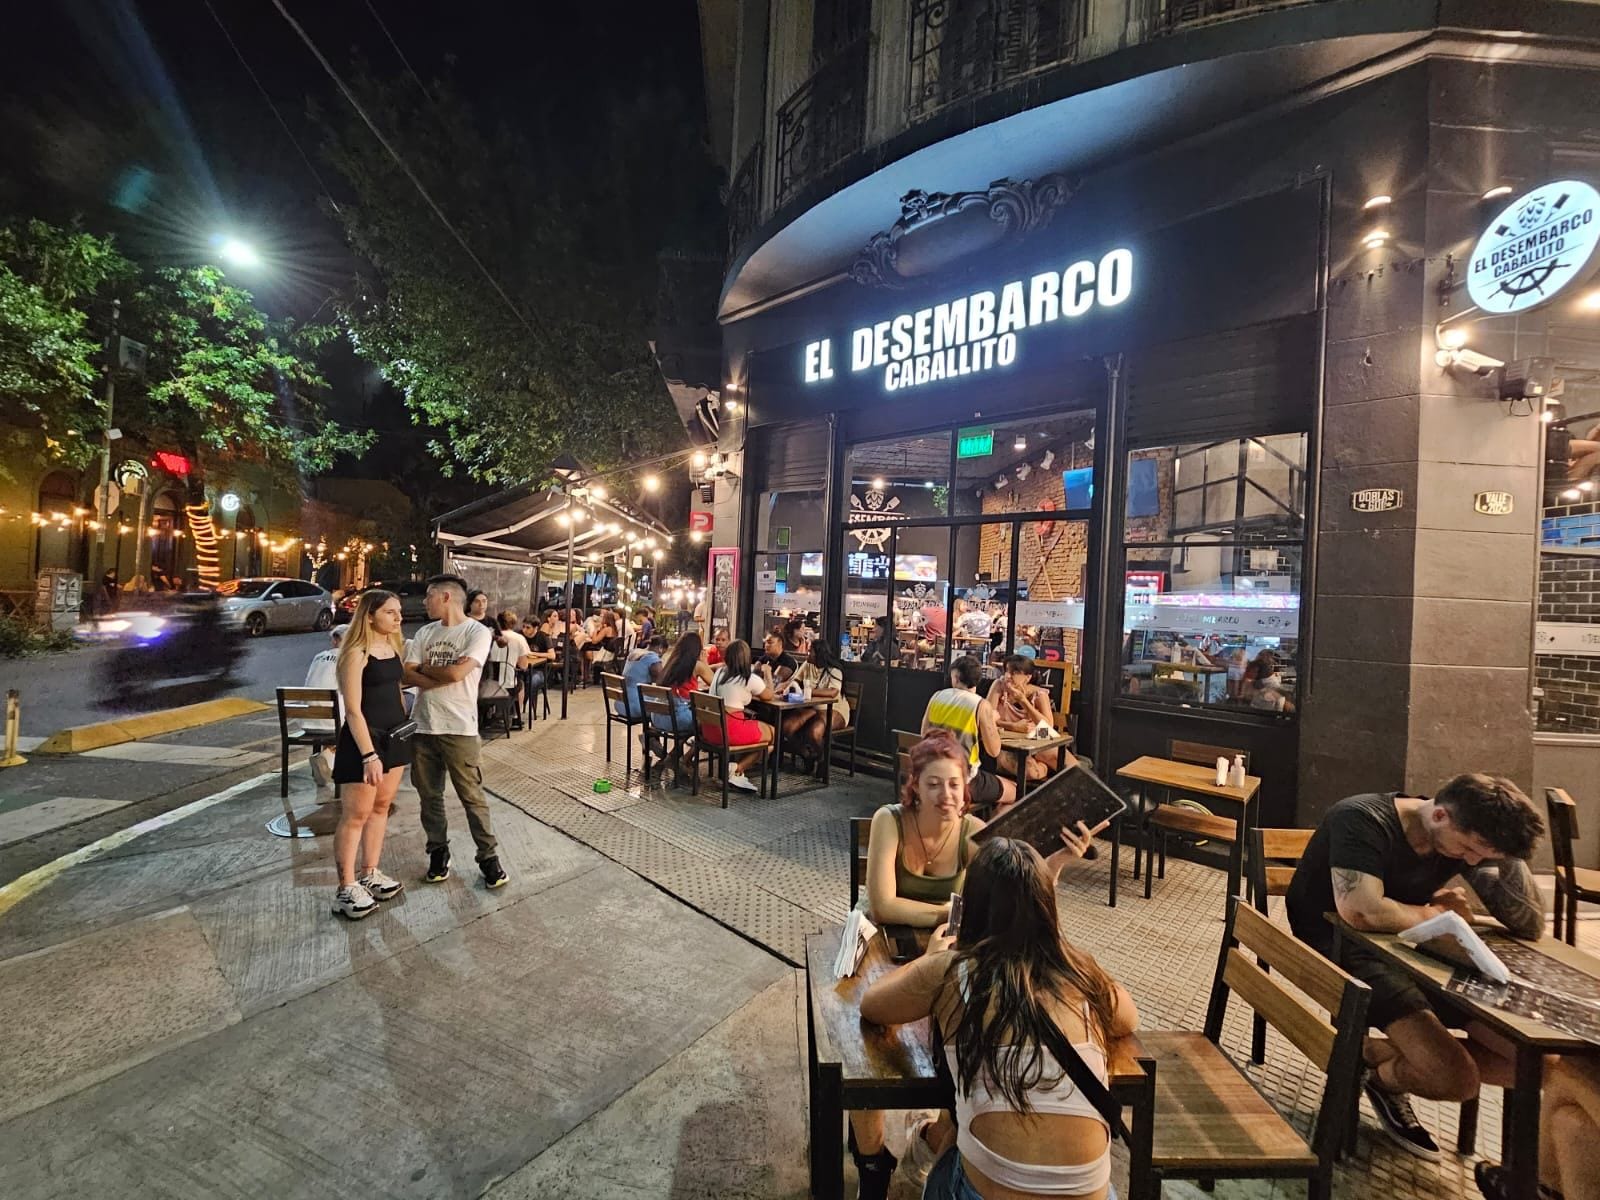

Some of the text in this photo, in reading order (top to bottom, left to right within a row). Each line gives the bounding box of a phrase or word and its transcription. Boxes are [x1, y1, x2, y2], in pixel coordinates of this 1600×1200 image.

[1474, 208, 1593, 274] EL DESEMBARCO
[1493, 237, 1565, 278] CABALLITO
[804, 248, 1134, 384] EL DESEMBARCO
[885, 332, 1017, 392] CABALLITO
